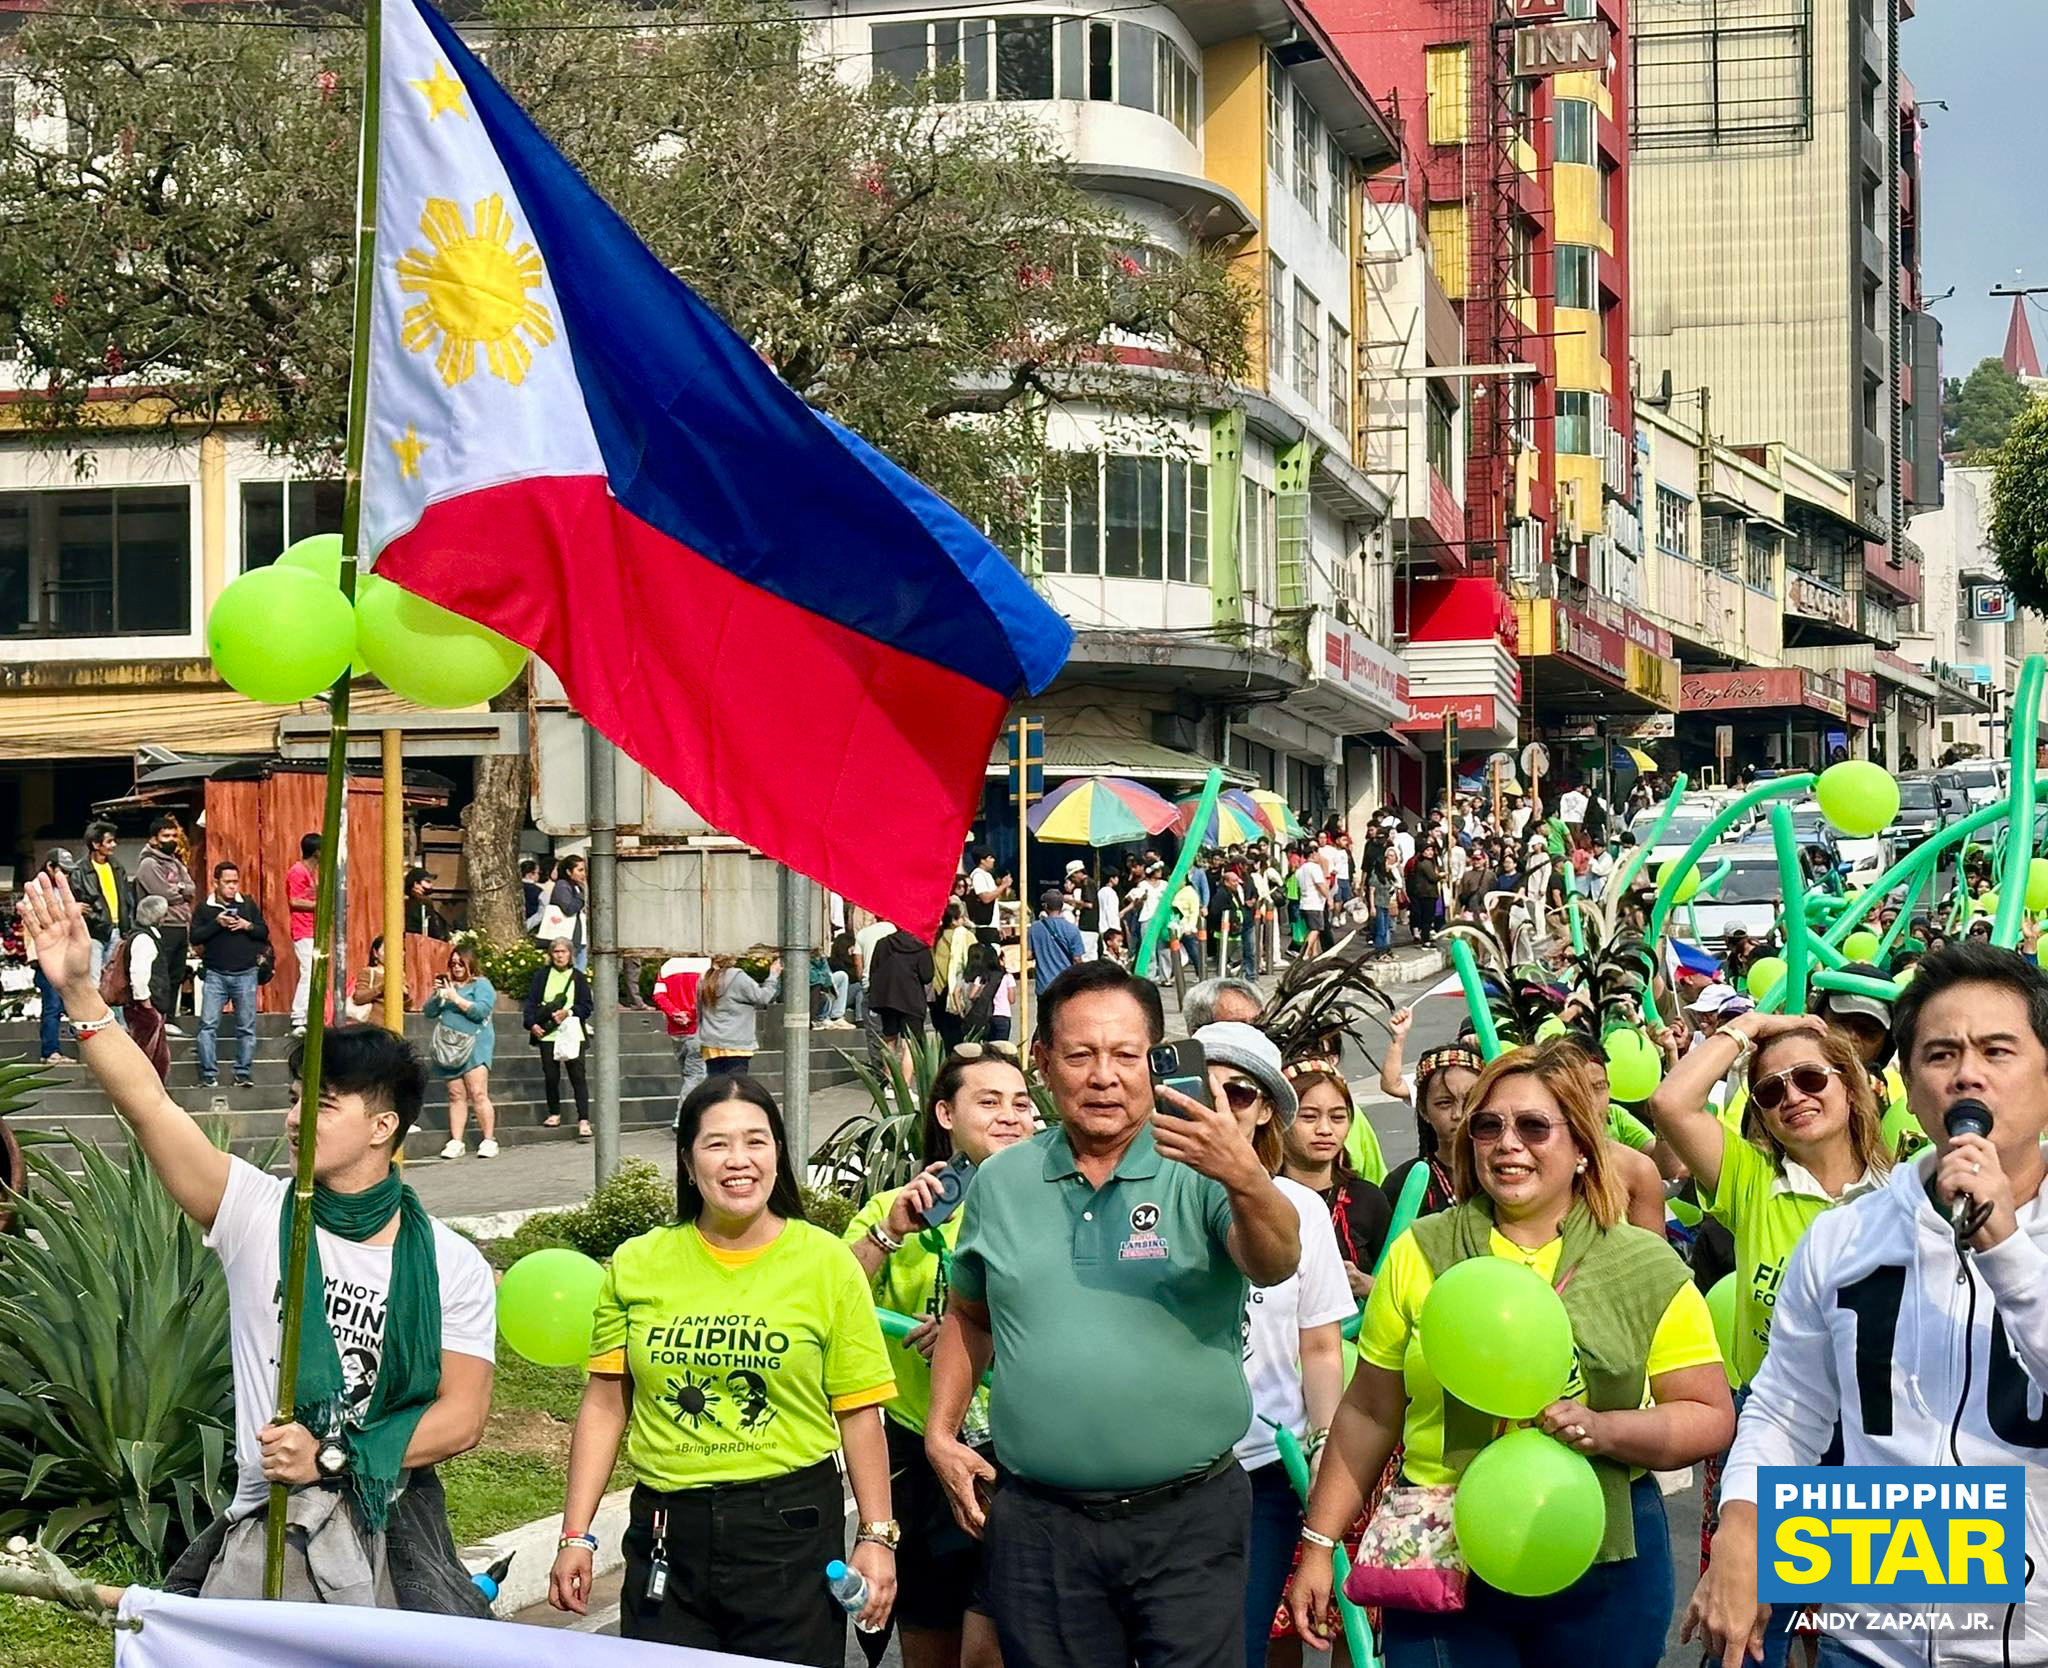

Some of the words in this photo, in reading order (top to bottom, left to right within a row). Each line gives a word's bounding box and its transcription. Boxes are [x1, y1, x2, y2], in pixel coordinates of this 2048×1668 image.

[1525, 29, 1598, 66] INN
[1351, 650, 1380, 690] mercury
[1380, 661, 1396, 699] drug
[1681, 678, 1767, 707] Stylish
[1134, 1210, 1157, 1226] 34
[323, 1276, 339, 1292] M
[341, 1281, 380, 1303] NOT
[1754, 1289, 1777, 1307] FO
[672, 1315, 679, 1326] I
[680, 1315, 711, 1327] AM
[713, 1314, 751, 1327] NOT
[753, 1317, 768, 1328] A
[332, 1324, 383, 1351] OTHIN
[646, 1326, 790, 1354] FILIPINO
[650, 1350, 689, 1365] FOR
[693, 1352, 782, 1370] NOTHING
[674, 1441, 778, 1456] #BringPRRDHome
